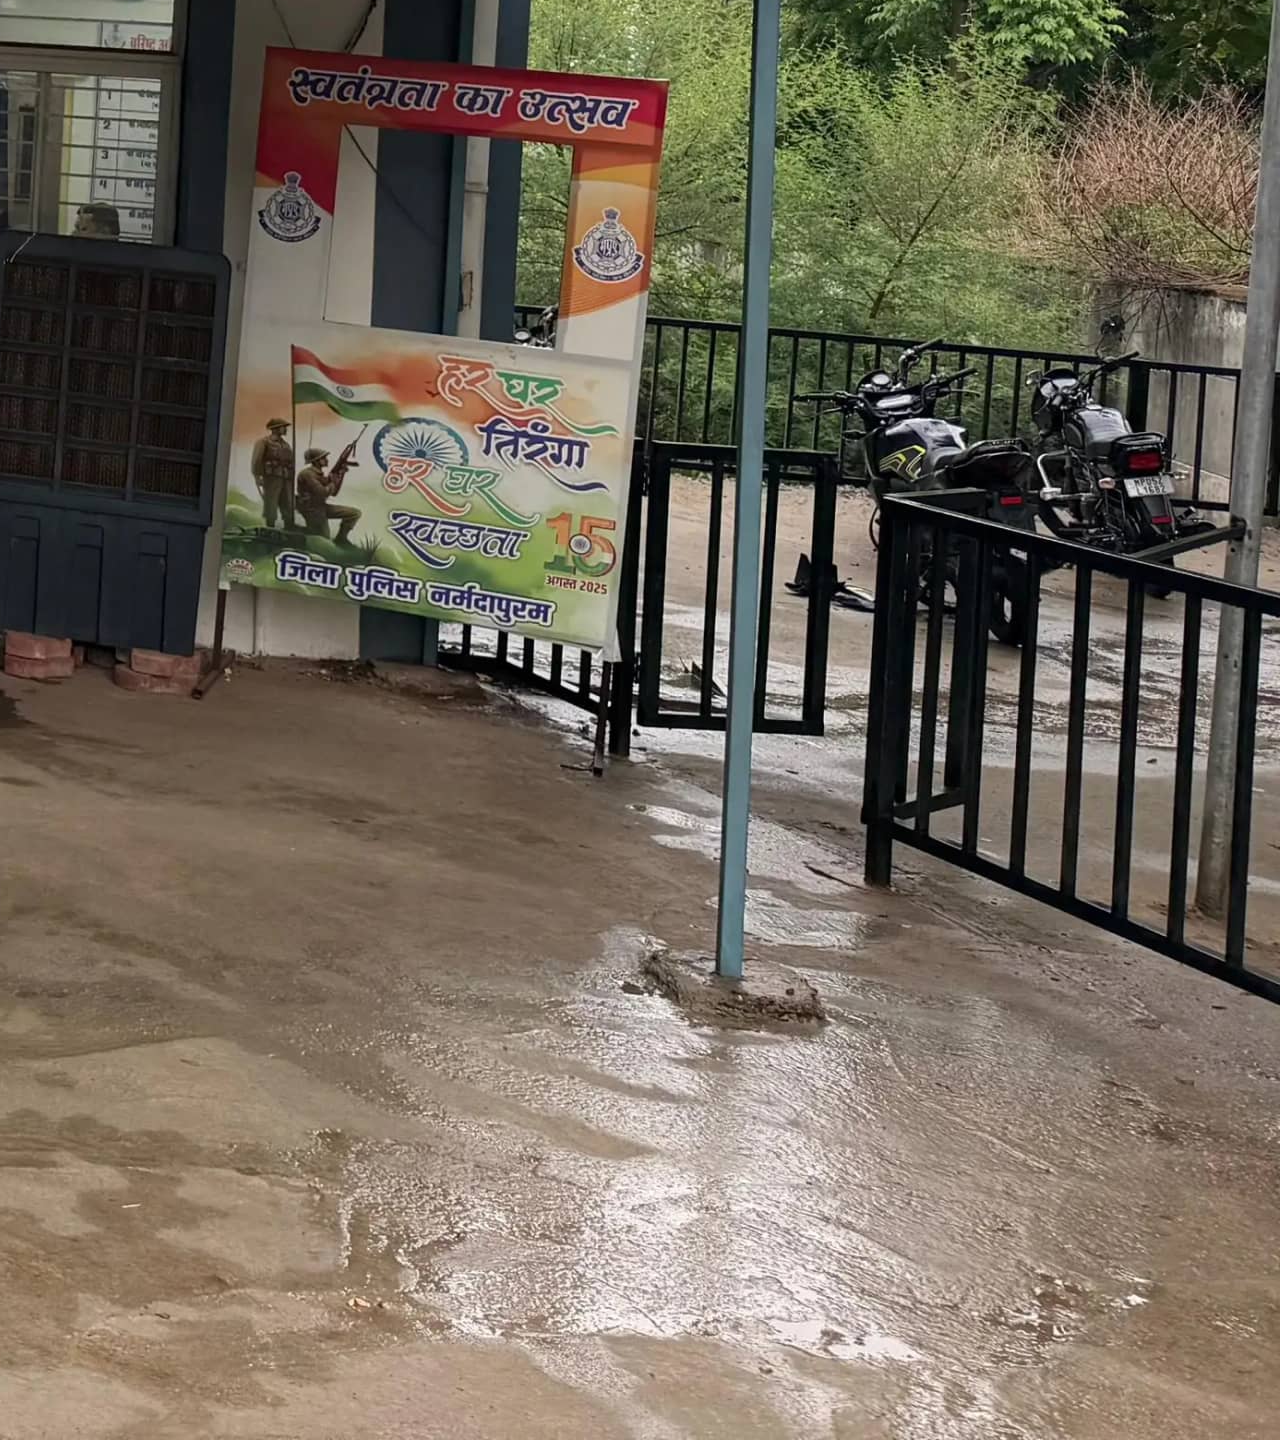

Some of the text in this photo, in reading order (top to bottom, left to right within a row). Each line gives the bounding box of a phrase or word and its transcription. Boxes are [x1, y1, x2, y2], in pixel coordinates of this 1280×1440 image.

[288, 65, 638, 133] स्वतंत्रता का उत्सव
[476, 416, 609, 493] तिरंगा
[383, 457, 539, 527] हर घर
[388, 511, 532, 568] स्वच्छता
[544, 512, 616, 578] 15
[276, 553, 340, 588] जिला
[345, 568, 419, 602] पुलिस
[427, 580, 555, 627] नर्मदापुरम
[544, 574, 607, 595] अगस्त 2025
